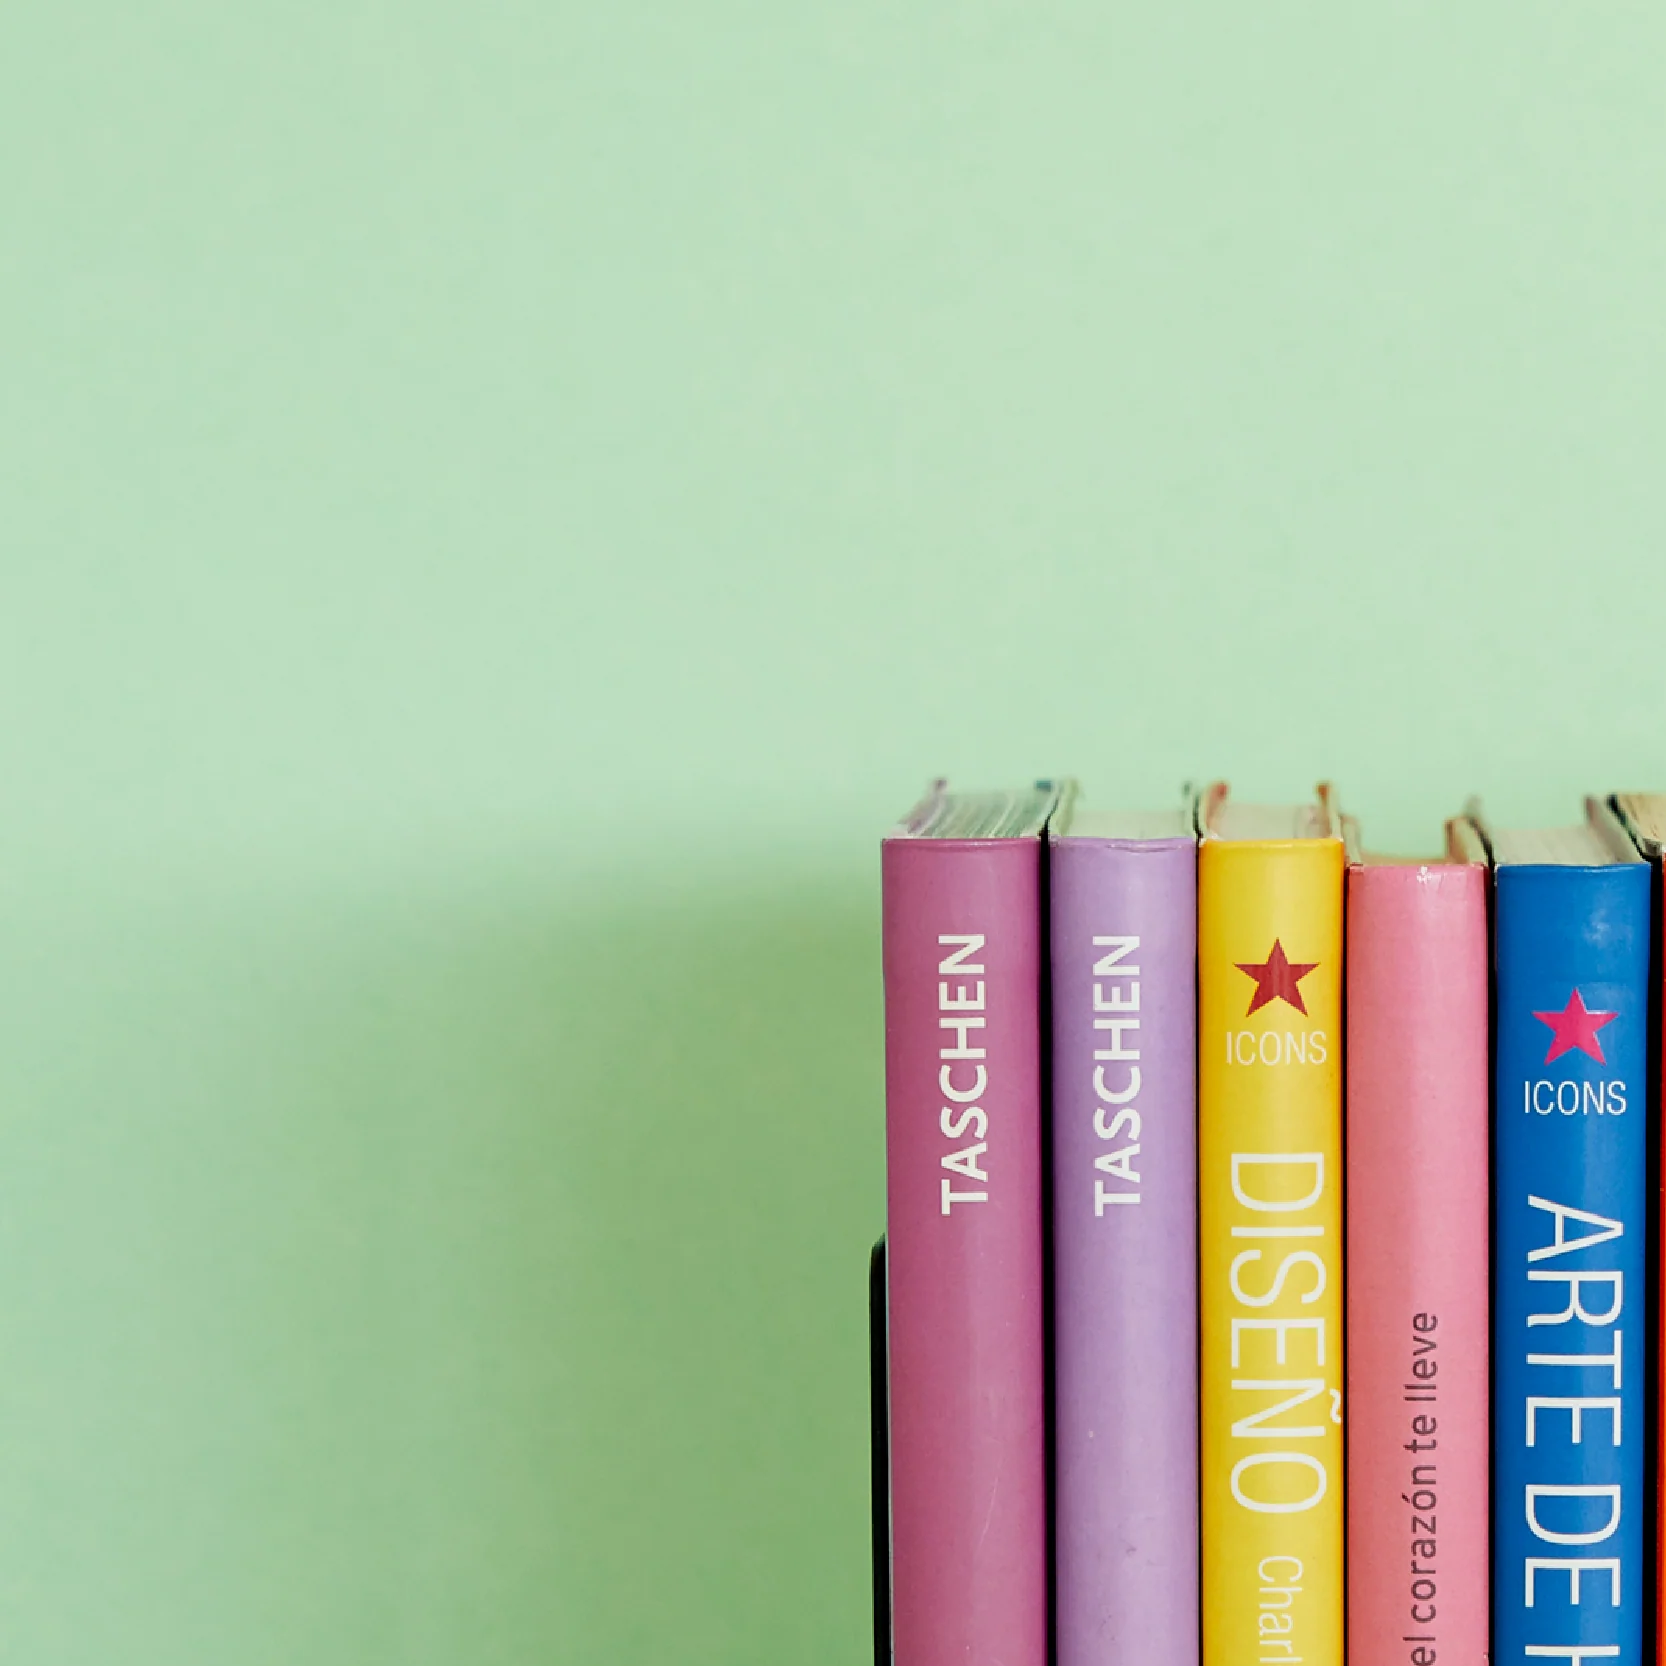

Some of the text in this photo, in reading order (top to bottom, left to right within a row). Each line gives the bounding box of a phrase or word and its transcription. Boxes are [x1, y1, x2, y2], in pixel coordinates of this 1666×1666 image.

[939, 934, 988, 1216] TASCHEN
[1092, 935, 1141, 1216] TASCHEN
[1226, 1032, 1327, 1066] ICONS
[1524, 1081, 1626, 1115] ICONS
[1230, 1152, 1341, 1514] DISEÑO
[1404, 1312, 1438, 1399] lleve
[1526, 1195, 1624, 1447] ARTE
[1405, 1414, 1437, 1454] te
[1401, 1464, 1437, 1624] corazón
[1524, 1484, 1621, 1607] DE
[1402, 1635, 1436, 1664] el
